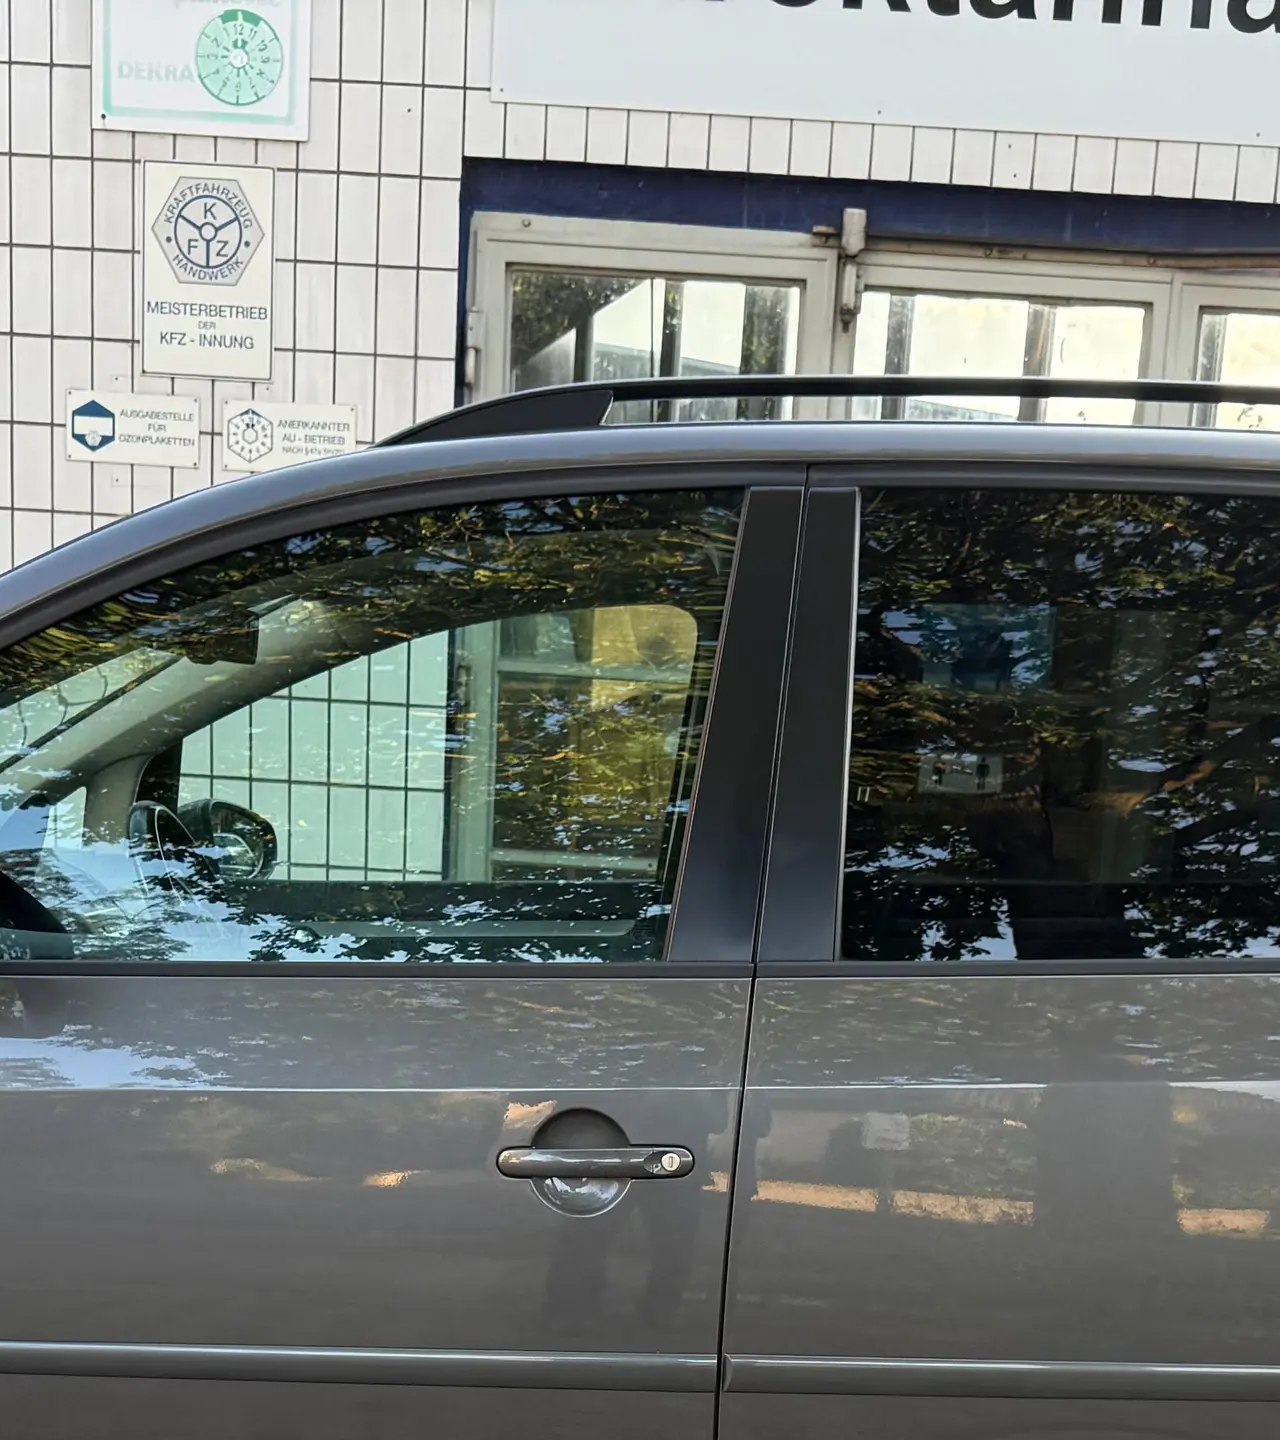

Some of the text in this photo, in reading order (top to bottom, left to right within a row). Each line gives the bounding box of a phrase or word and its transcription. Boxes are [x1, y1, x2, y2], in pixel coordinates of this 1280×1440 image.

[117, 61, 196, 83] DEKRA
[164, 182, 253, 229] KRAFTFAHRZEUG
[172, 254, 244, 282] HANDWERK
[147, 301, 268, 320] MEISTERBETRIEB
[198, 321, 216, 330] DER
[120, 409, 195, 422] AUSGABESTELLE
[147, 422, 167, 432] FÜR
[277, 419, 350, 432] ANERKANNTER
[118, 434, 196, 447] OZONPLAKETTEN
